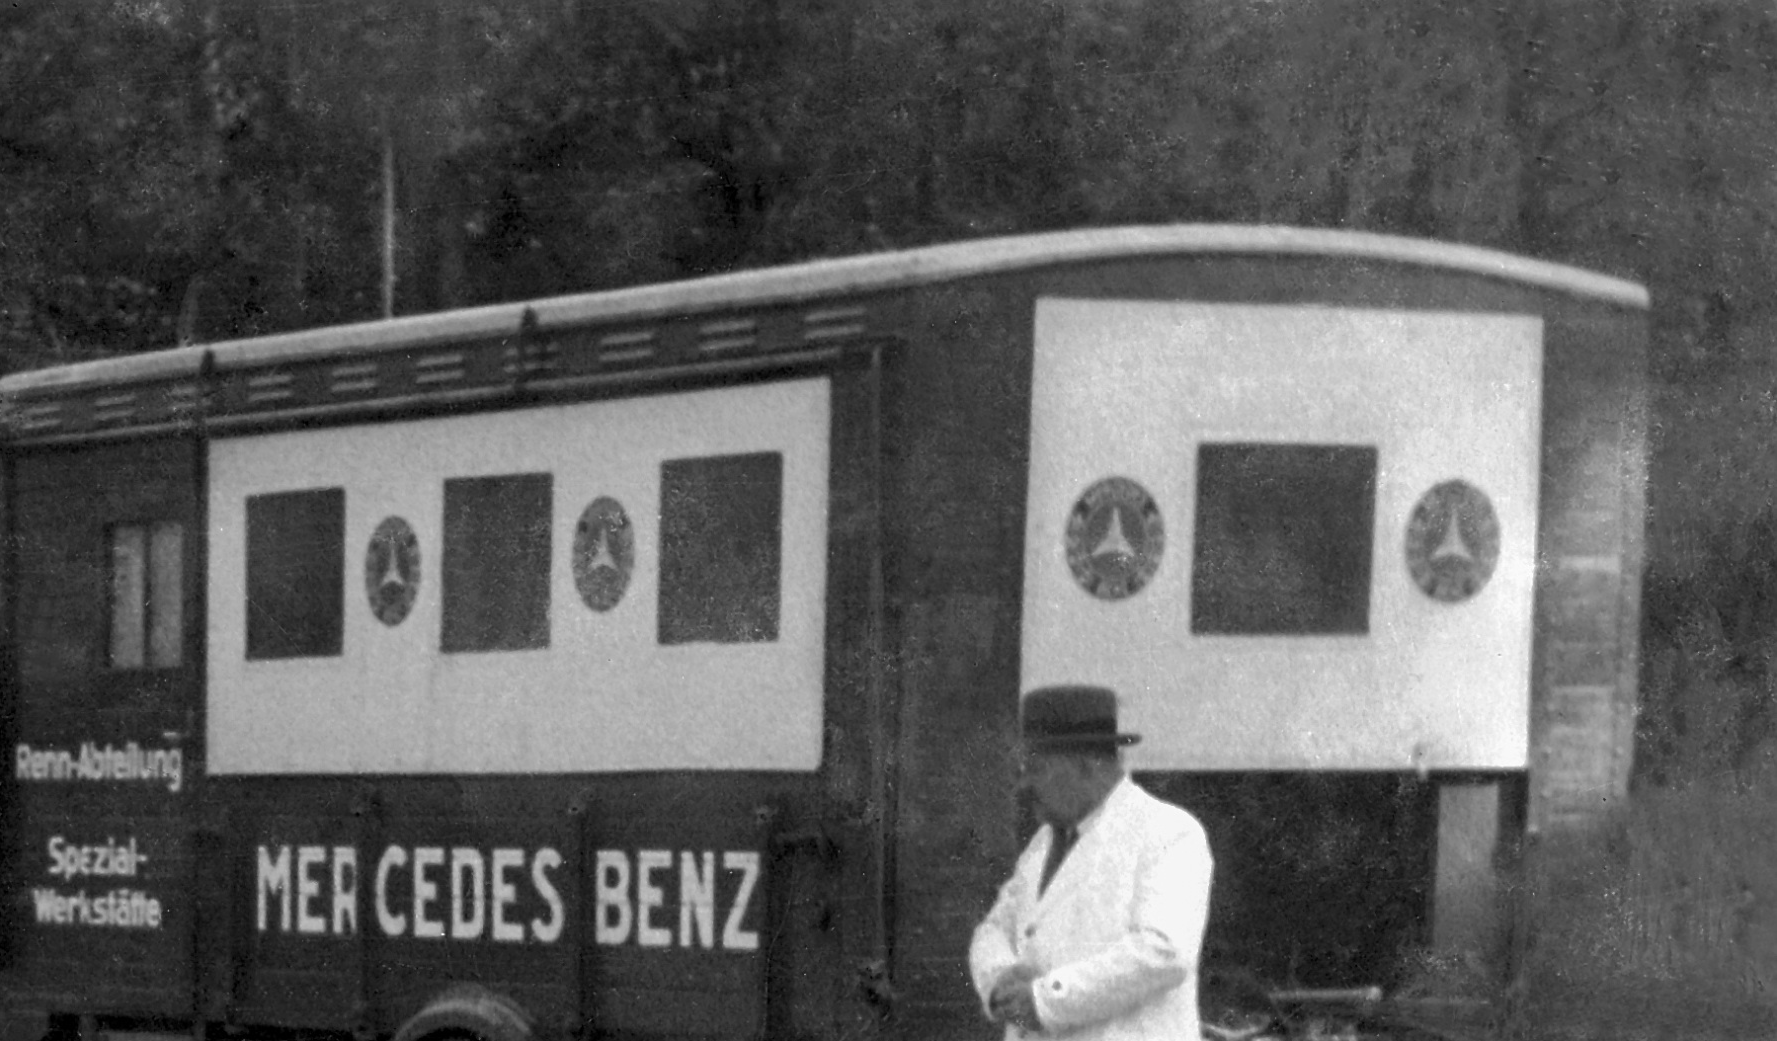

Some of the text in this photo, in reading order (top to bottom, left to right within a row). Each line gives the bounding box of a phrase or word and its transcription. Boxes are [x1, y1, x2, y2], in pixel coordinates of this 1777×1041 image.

[16, 740, 182, 792] Renn-Abteilung
[47, 836, 148, 881] Spezial-
[32, 887, 162, 928] Werkstätte
[256, 844, 760, 951] MERCEDES BENZ
